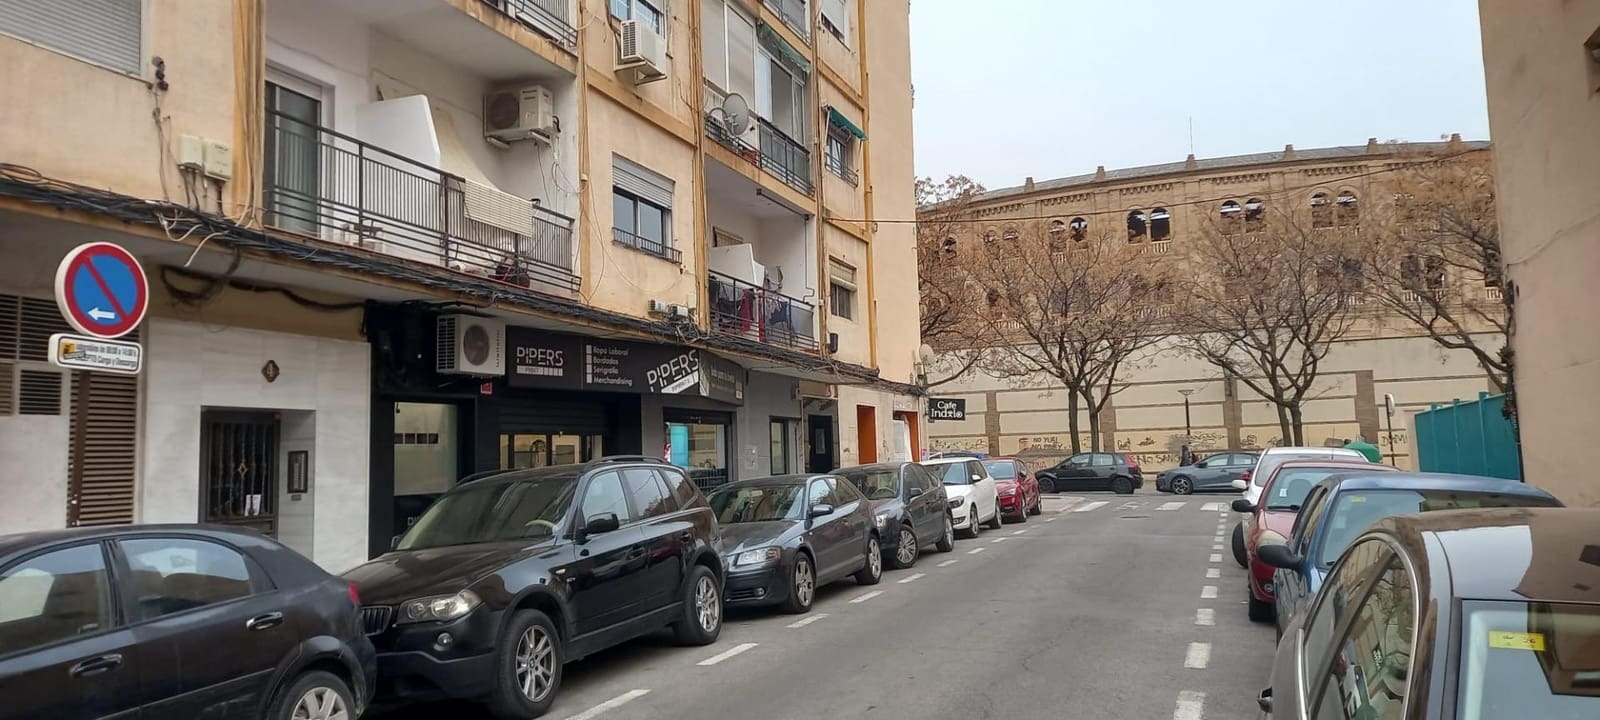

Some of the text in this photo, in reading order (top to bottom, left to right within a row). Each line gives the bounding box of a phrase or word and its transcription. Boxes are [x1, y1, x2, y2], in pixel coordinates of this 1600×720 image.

[516, 346, 564, 367] PIPERS
[593, 346, 629, 356] Ropa Laboral
[593, 356, 619, 365] Bordados
[646, 349, 699, 393] PIPERS
[593, 376, 633, 387] Merchandising
